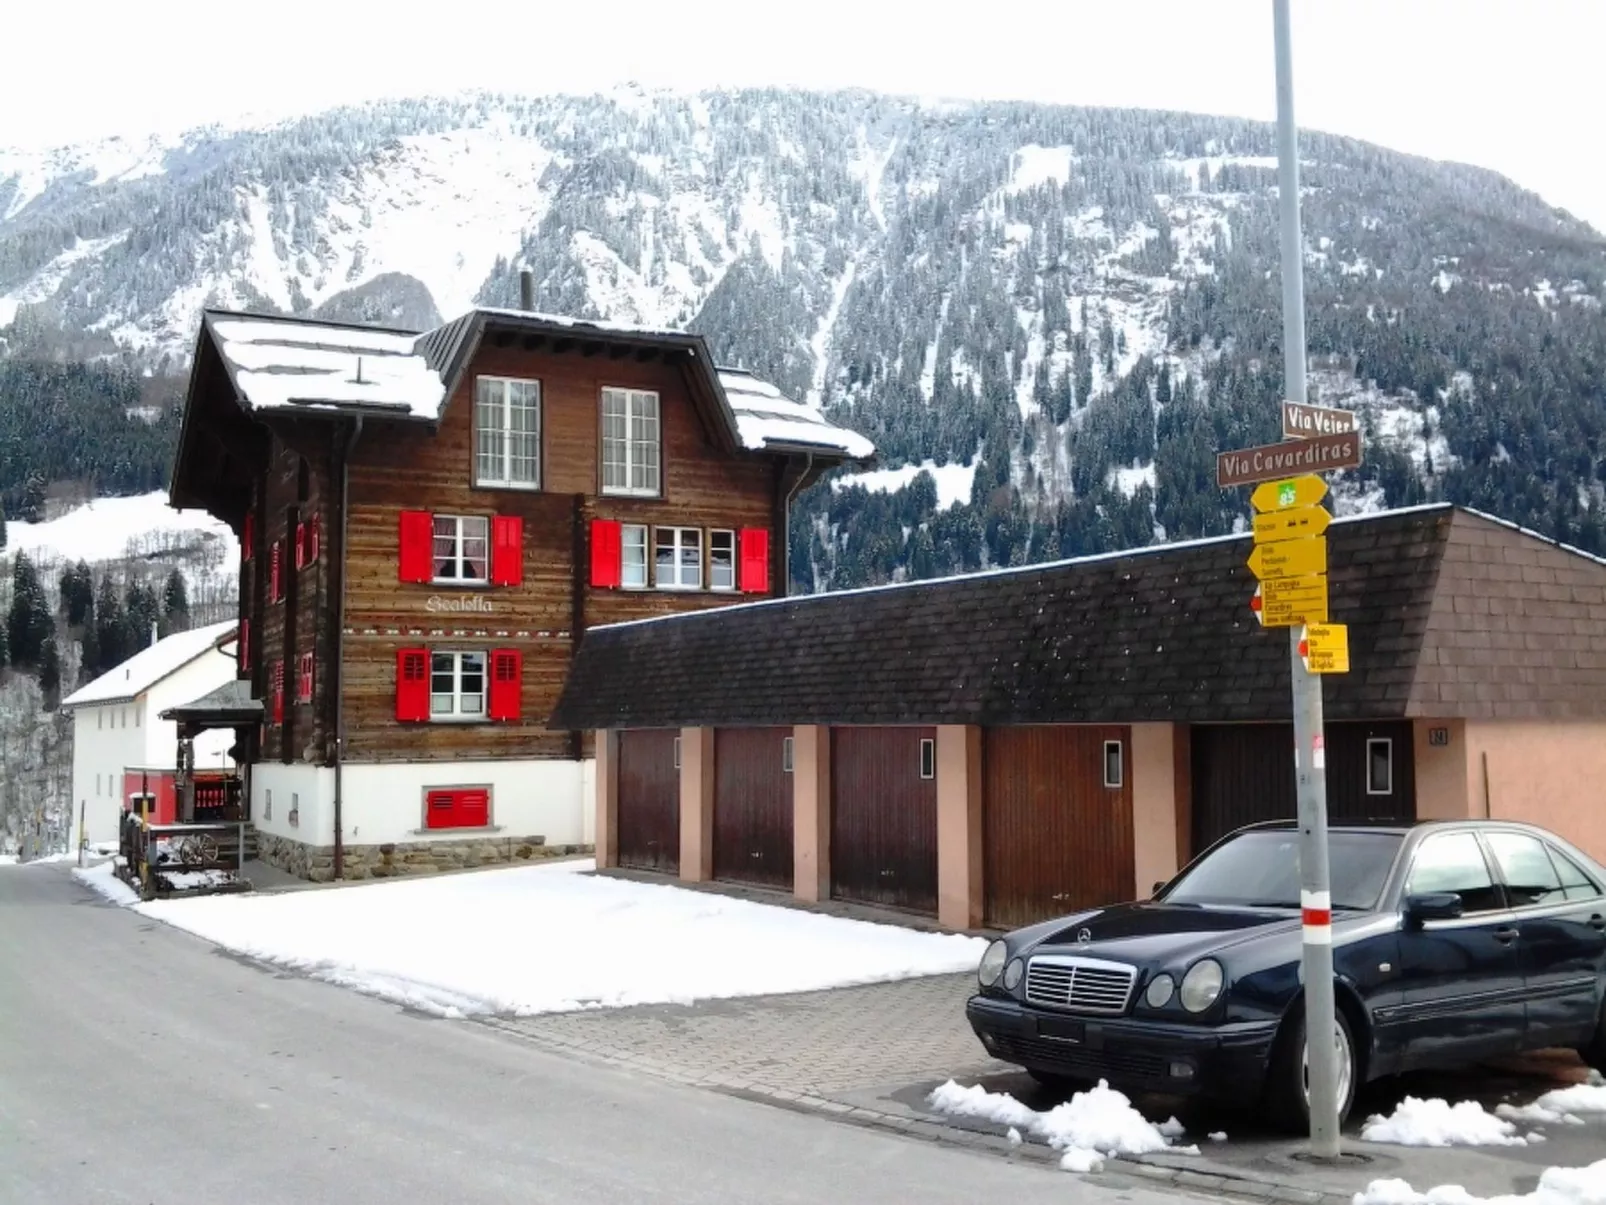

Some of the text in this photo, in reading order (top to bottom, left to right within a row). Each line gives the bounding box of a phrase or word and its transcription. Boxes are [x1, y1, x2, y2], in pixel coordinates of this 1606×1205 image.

[1288, 406, 1311, 430] Via
[1224, 442, 1352, 478] Via Cavardiras
